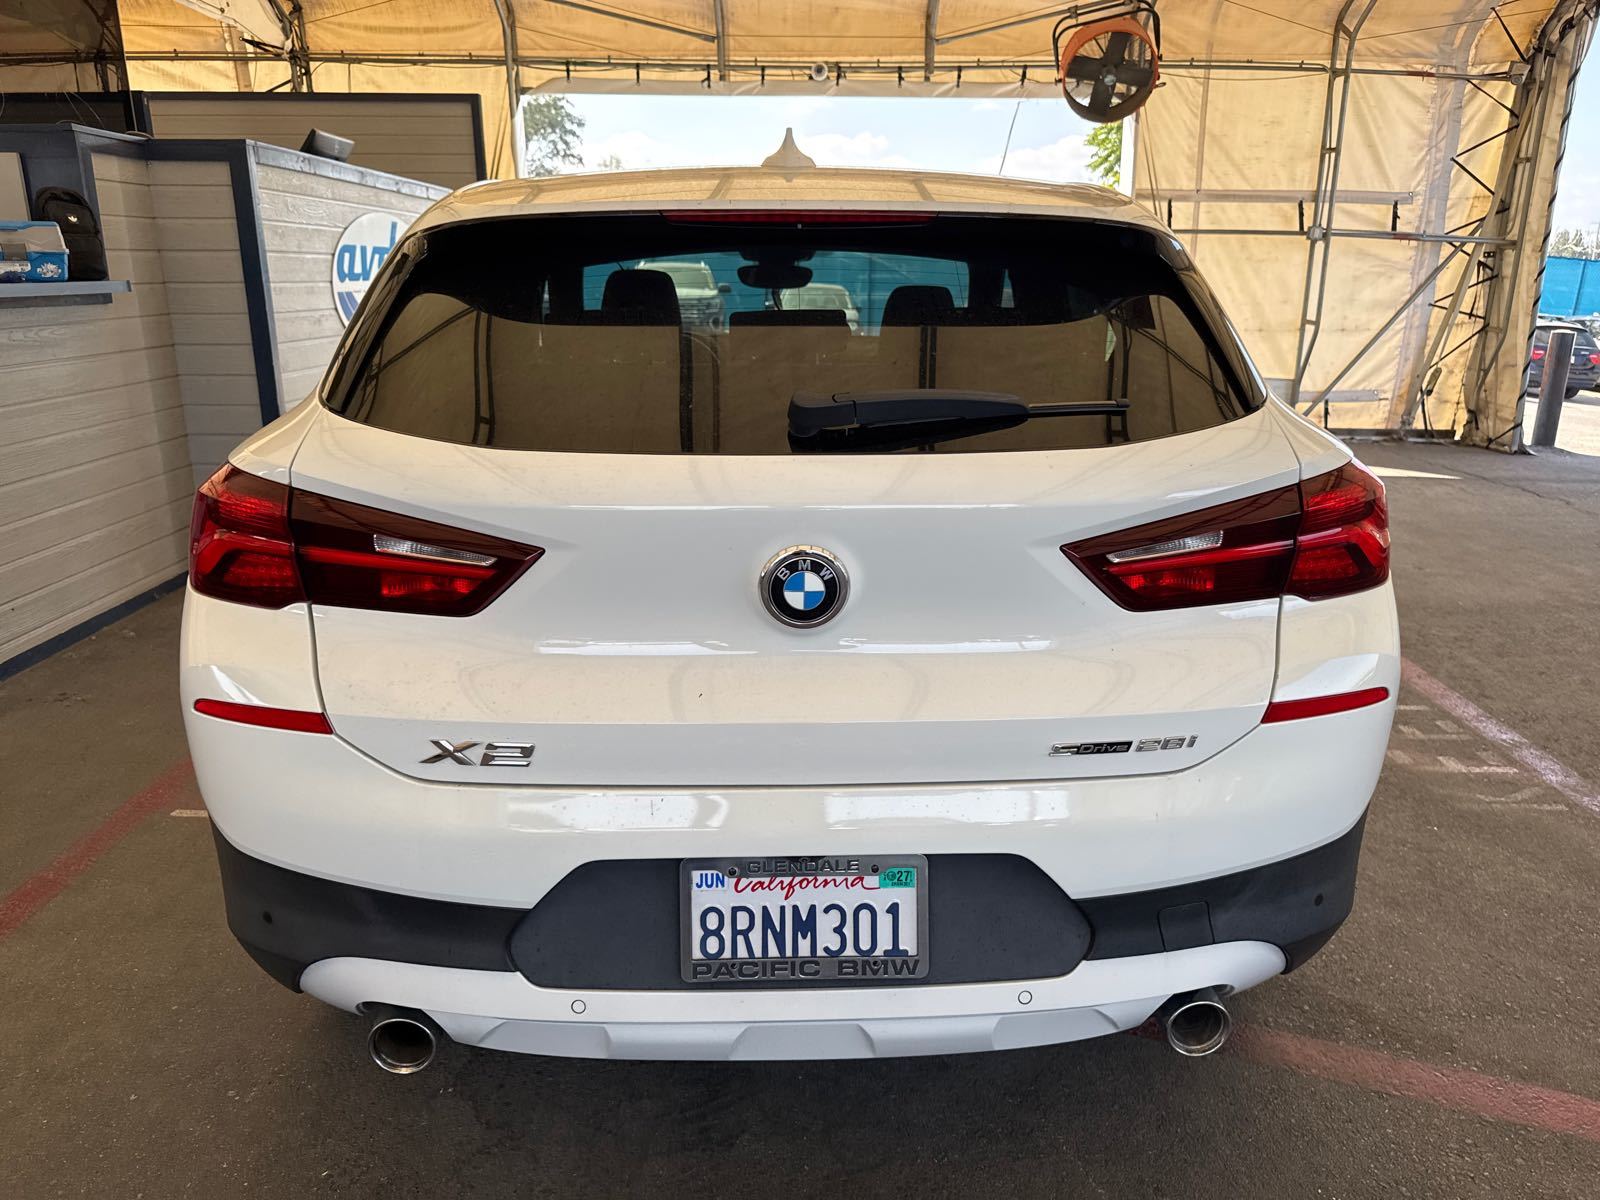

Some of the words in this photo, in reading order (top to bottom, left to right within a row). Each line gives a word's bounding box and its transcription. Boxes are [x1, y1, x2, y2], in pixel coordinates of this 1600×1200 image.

[776, 559, 834, 581] BMW
[418, 739, 536, 767] X2
[747, 858, 860, 875] GLENDALE
[896, 870, 911, 882] 27
[695, 872, 726, 889] JUN
[733, 875, 880, 900] California
[699, 902, 909, 960] 8RNM301
[692, 960, 821, 980] PACIFIC
[837, 959, 920, 976] BMW
